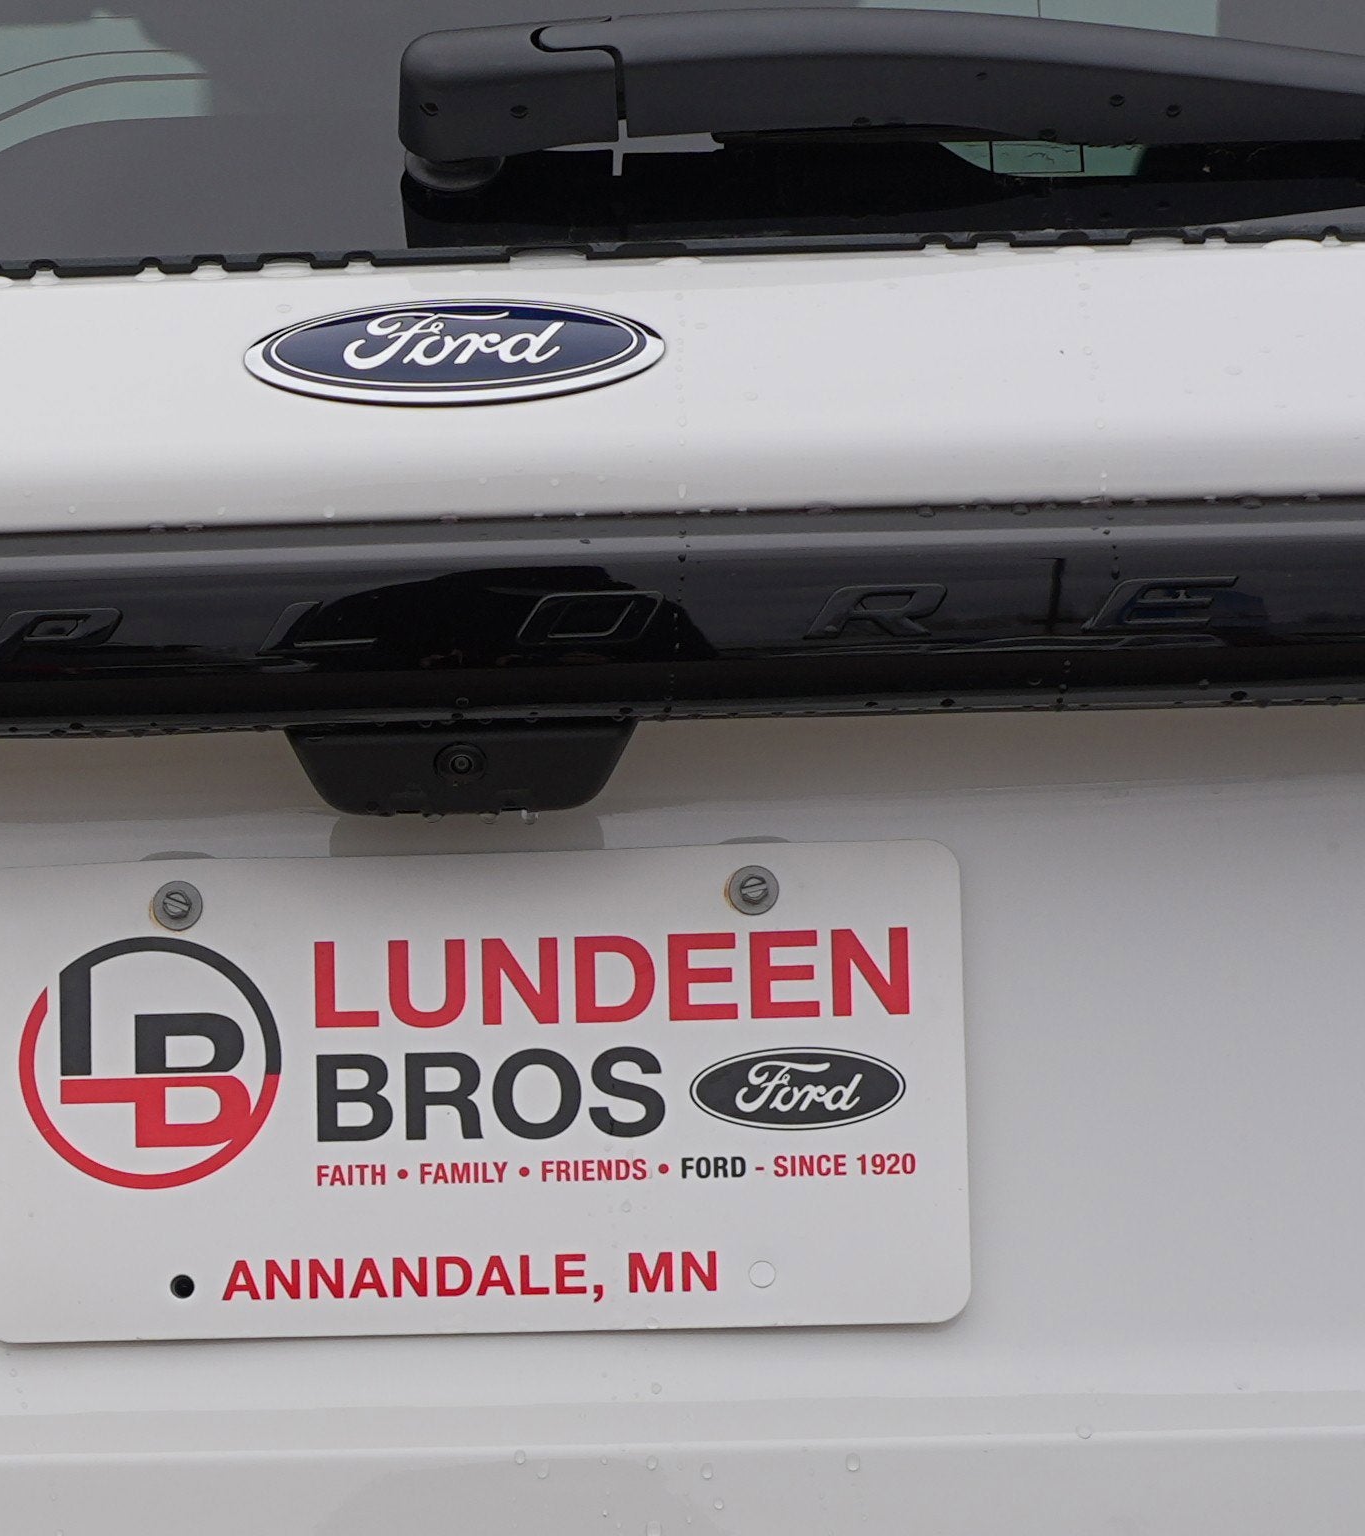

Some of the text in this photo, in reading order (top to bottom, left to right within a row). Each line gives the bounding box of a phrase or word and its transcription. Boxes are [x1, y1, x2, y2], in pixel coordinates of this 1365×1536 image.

[343, 311, 566, 370] Ford
[313, 926, 911, 1029] LUNDEEN
[315, 1046, 863, 1143] BROS Ford
[316, 1163, 387, 1187] FAITH
[419, 1161, 508, 1185] FAMILY
[541, 1158, 648, 1183] FRIENDS
[680, 1156, 746, 1179] FORD
[773, 1154, 847, 1178] SINCE
[856, 1152, 916, 1176] 1920
[222, 1250, 718, 1303] ANNANDALE, MN
